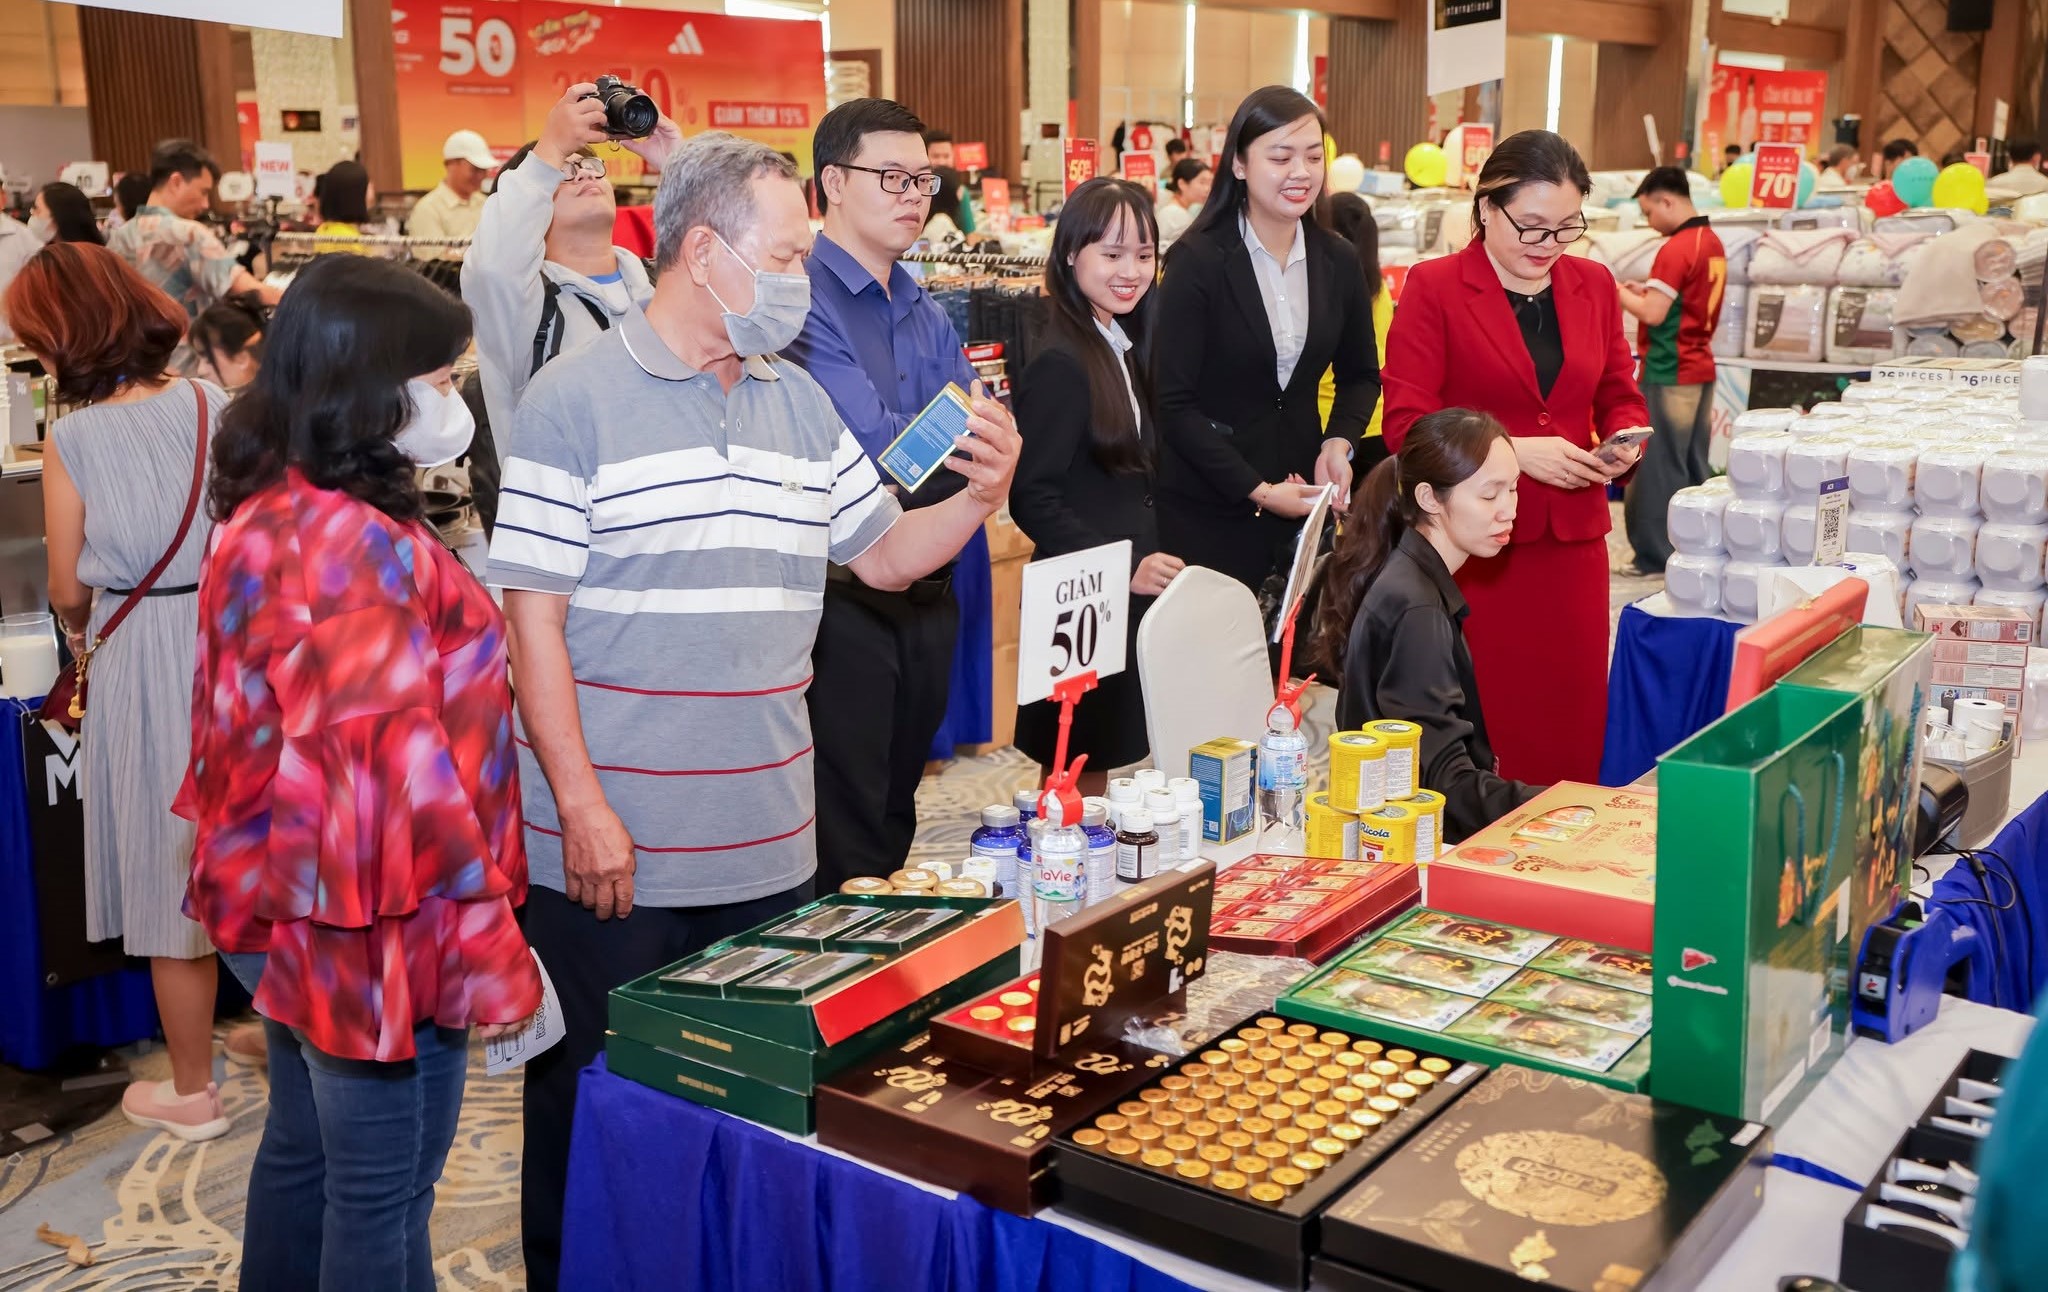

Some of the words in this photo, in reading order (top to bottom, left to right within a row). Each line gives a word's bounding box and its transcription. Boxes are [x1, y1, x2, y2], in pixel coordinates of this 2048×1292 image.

[259, 159, 289, 173] NEW
[1704, 256, 1727, 331] 7
[1981, 374, 2020, 384] PIÈCE
[1055, 569, 1103, 604] GIẢM
[1360, 822, 1390, 838] Ricola
